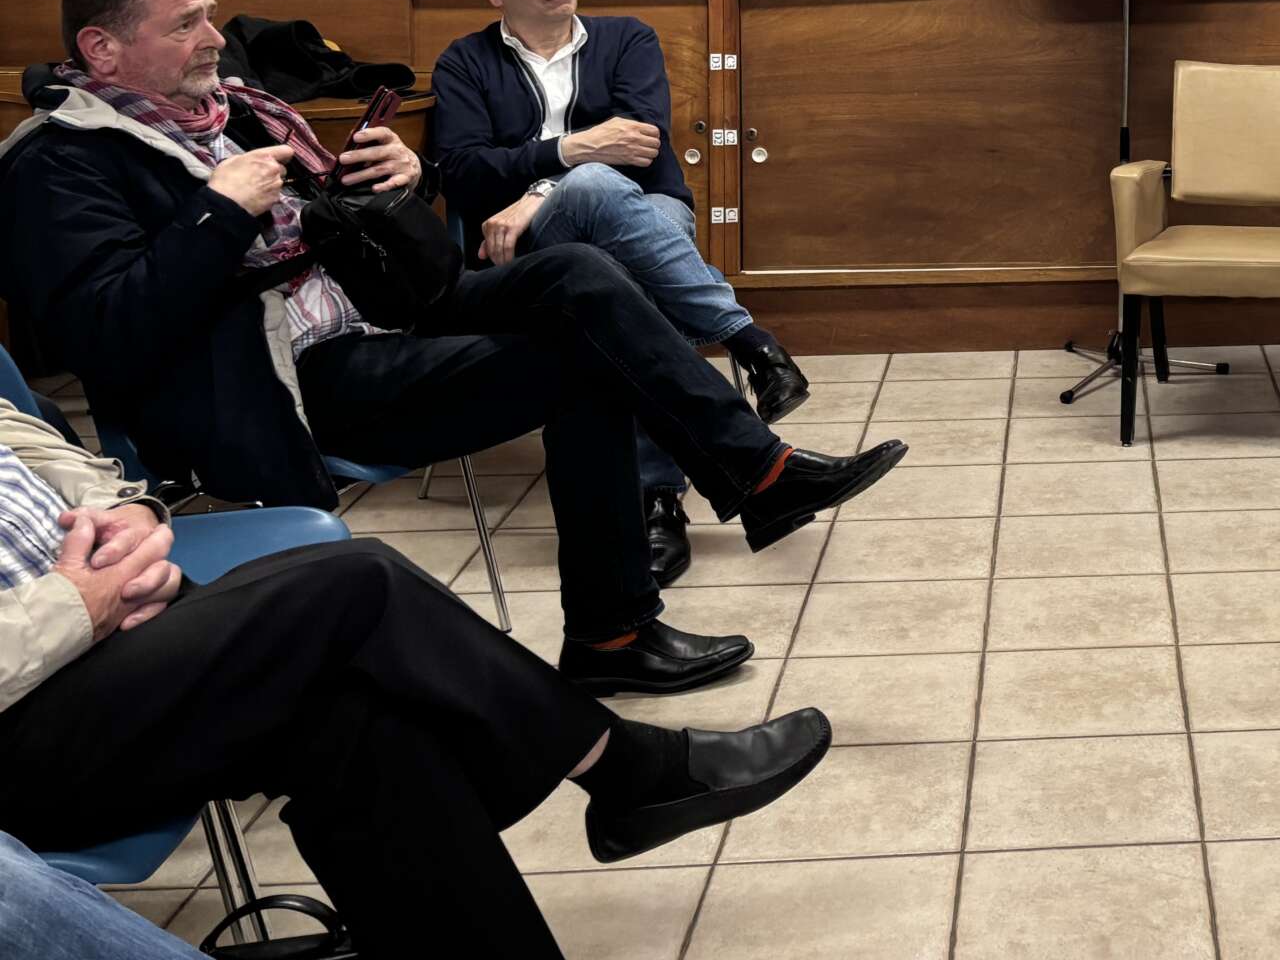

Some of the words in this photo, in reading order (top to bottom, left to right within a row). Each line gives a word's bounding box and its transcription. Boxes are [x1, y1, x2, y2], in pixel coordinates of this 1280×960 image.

[712, 56, 721, 68] D3
[713, 131, 723, 144] D2
[725, 131, 736, 144] C2
[712, 209, 722, 222] D1
